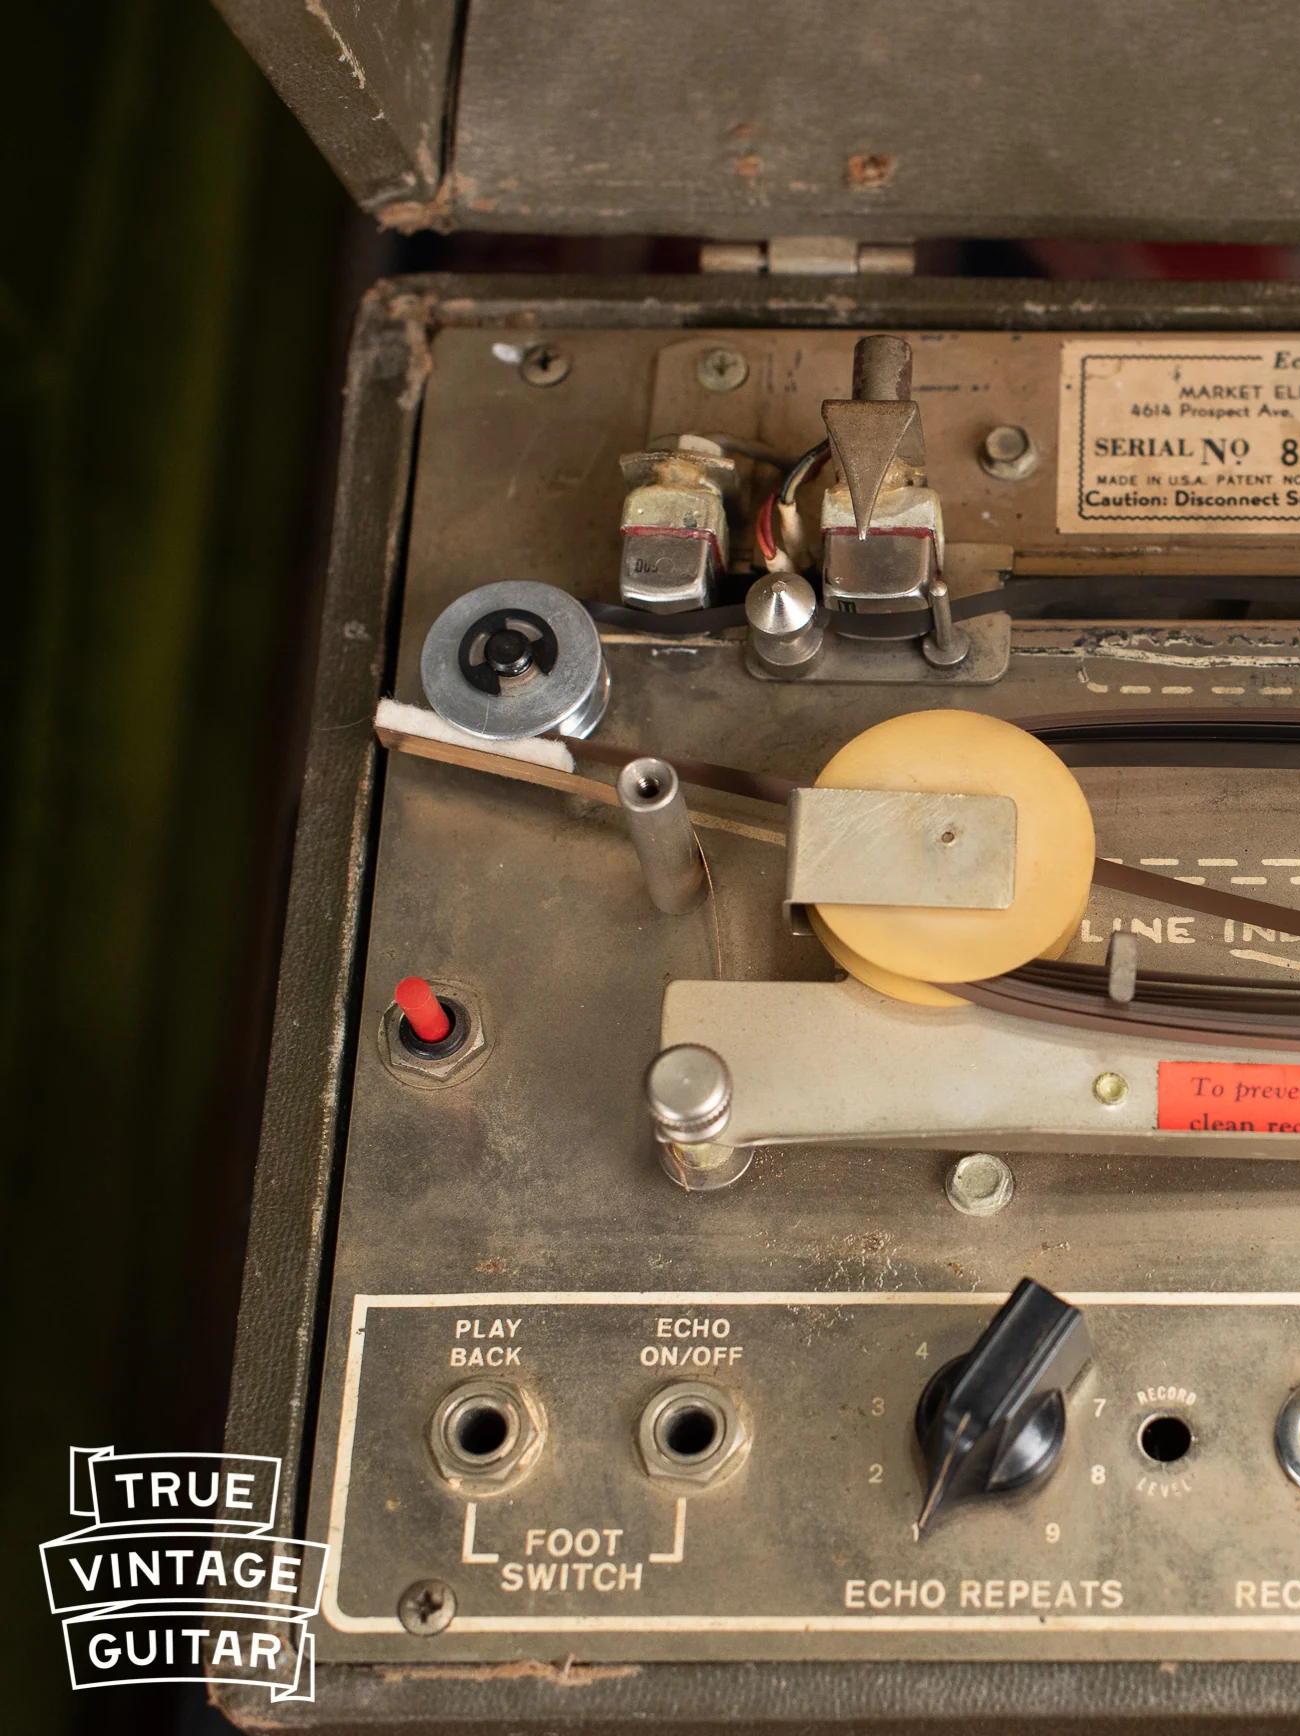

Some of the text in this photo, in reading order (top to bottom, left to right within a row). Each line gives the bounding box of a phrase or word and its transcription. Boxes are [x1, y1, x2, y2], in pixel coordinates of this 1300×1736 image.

[1179, 385, 1263, 400] MARKET
[1131, 403, 1172, 417] 4614
[1180, 403, 1250, 420] Prospect
[1094, 437, 1194, 457] SERIAL
[1097, 475, 1137, 486] MADE
[1147, 475, 1160, 486] IN
[1169, 475, 1208, 486] U.S.A.
[1217, 475, 1273, 486] PATENT
[1085, 490, 1168, 507] Caution:
[1175, 490, 1280, 507] Disconnect
[1191, 1077, 1224, 1098] To
[1190, 1113, 1255, 1132] clean
[455, 1318, 523, 1339] PLAY
[656, 1318, 731, 1339] ECHO
[449, 1346, 522, 1367] BACK
[639, 1346, 744, 1367] ON/OFF
[915, 1342, 929, 1360] 4
[1136, 1385, 1197, 1406] RECORD
[871, 1397, 885, 1416] 3
[1093, 1398, 1107, 1417] 7
[868, 1464, 883, 1484] 2
[1091, 1464, 1106, 1485] 8
[1136, 1477, 1192, 1498] LEVEL
[525, 1528, 625, 1557] FOOT
[911, 1521, 920, 1543] 1
[1045, 1522, 1061, 1544] 9
[500, 1562, 644, 1592] SWITCH
[844, 1579, 1124, 1609] ECHO REPEATS
